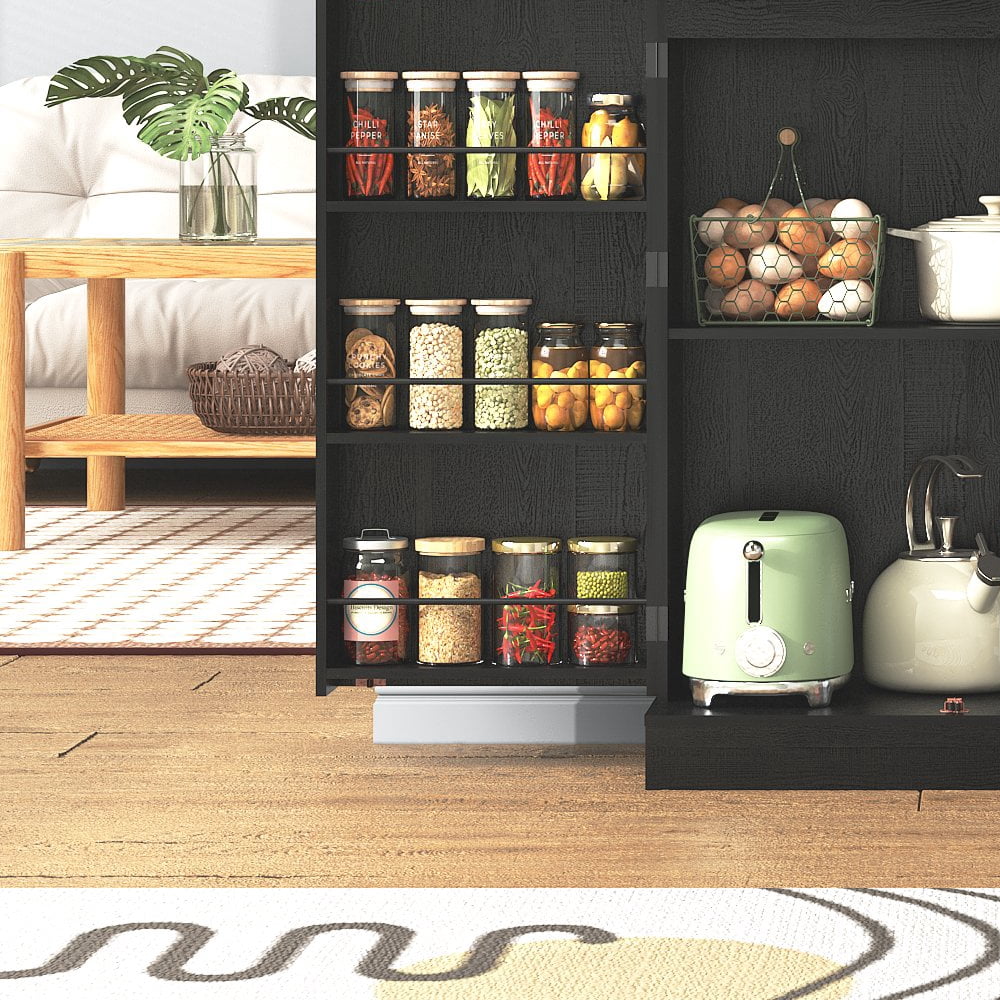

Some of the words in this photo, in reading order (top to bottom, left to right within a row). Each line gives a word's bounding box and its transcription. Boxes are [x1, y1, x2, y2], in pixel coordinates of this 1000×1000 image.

[352, 120, 380, 128] CHILLI
[418, 120, 438, 128] STAR
[536, 120, 562, 128] CHILLI
